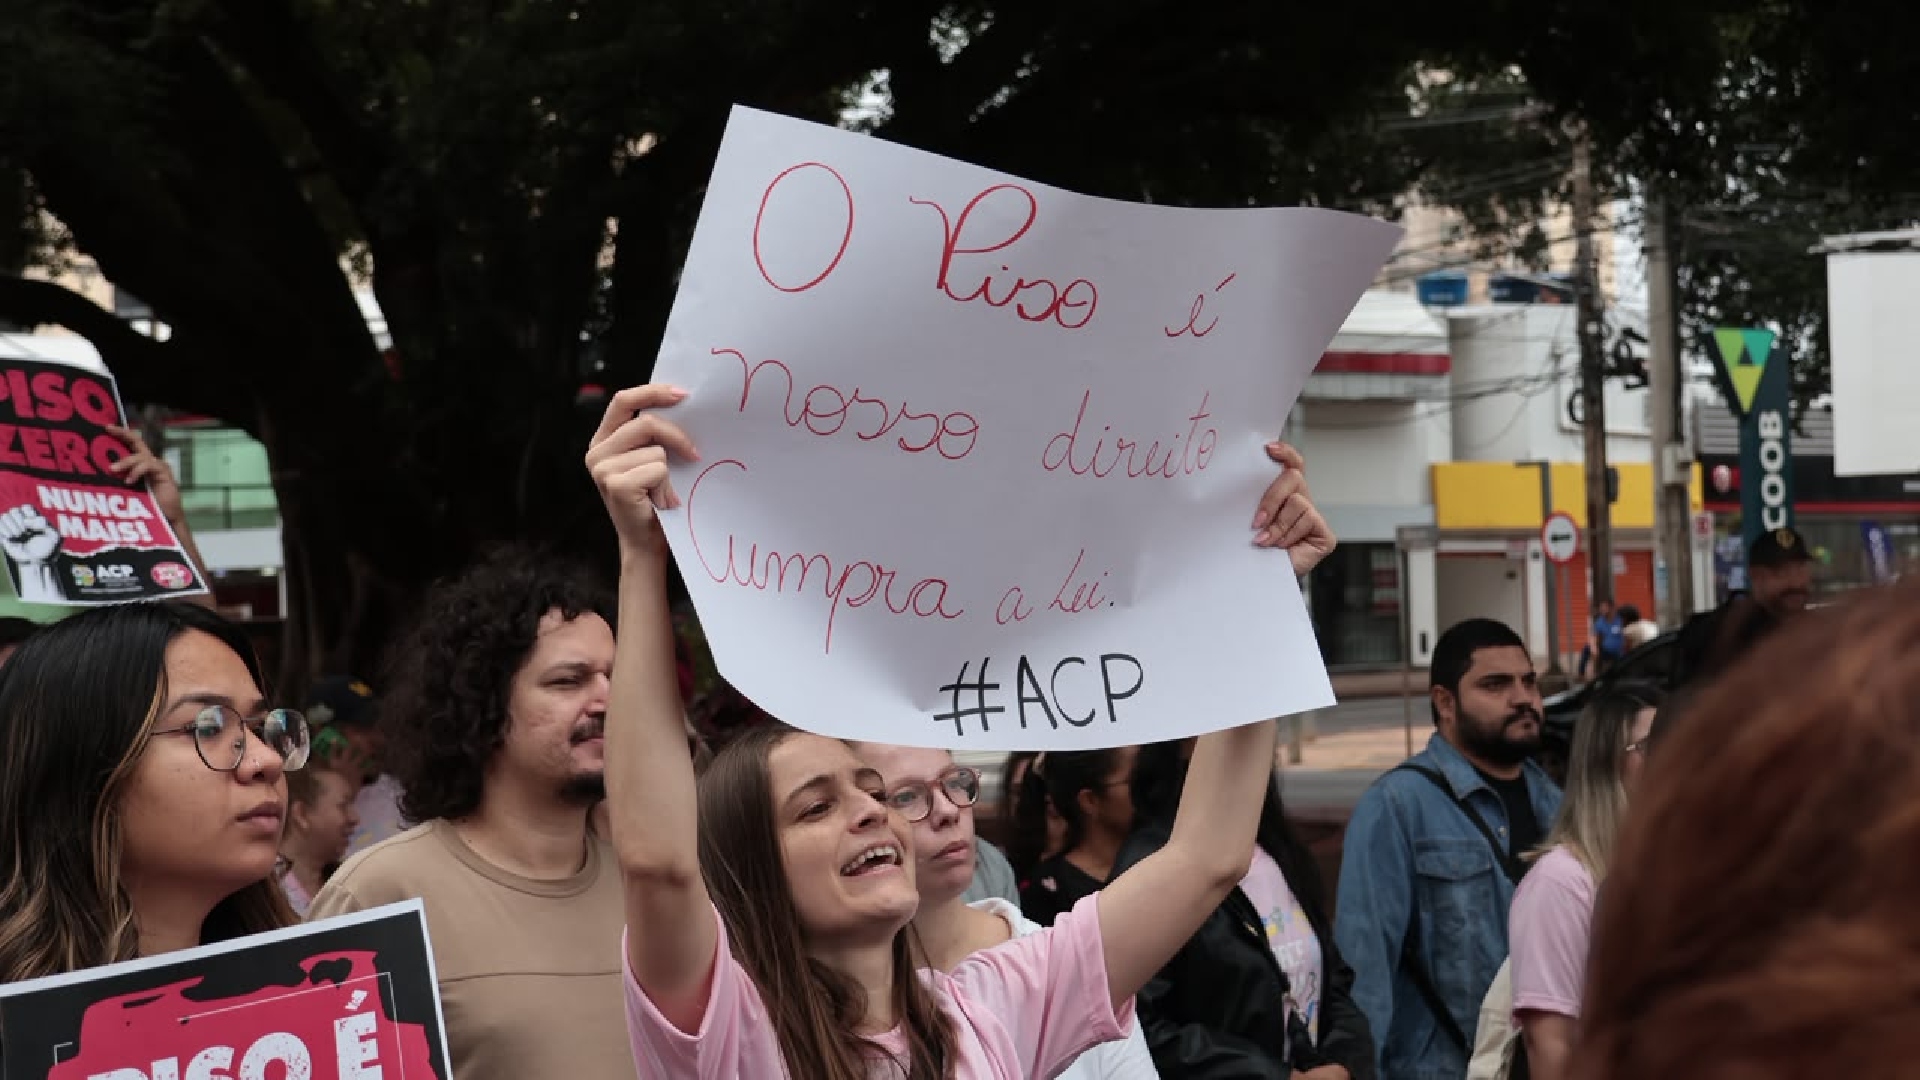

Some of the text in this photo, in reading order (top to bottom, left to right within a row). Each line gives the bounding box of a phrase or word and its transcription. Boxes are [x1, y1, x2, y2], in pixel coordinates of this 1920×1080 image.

[752, 161, 1237, 338] O Piso é
[0, 424, 131, 478] ZERO
[1041, 389, 1217, 479] direito
[36, 485, 153, 519] NUNCA
[57, 513, 153, 543] MAIS!
[687, 458, 965, 655] Cumpra
[995, 586, 1034, 625] a
[932, 652, 1145, 737] #ACP
[333, 989, 383, 1080] É
